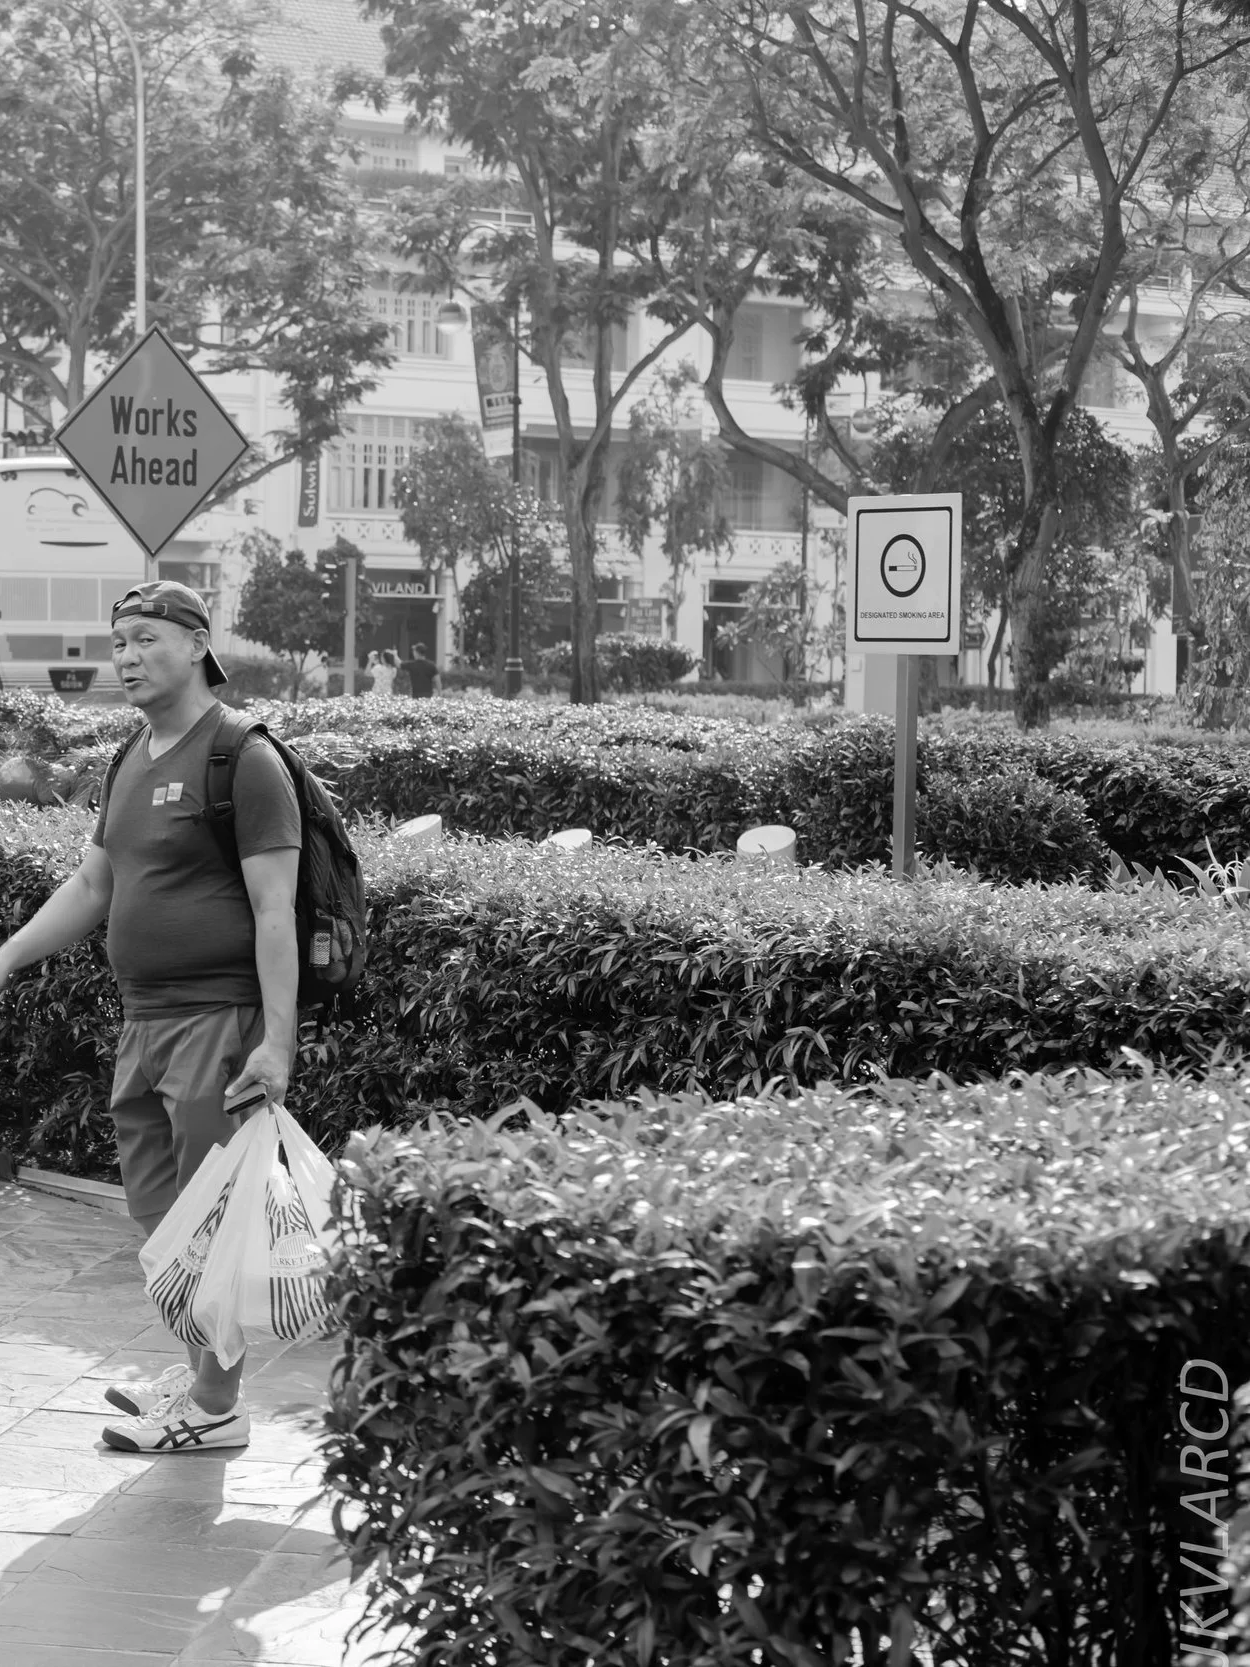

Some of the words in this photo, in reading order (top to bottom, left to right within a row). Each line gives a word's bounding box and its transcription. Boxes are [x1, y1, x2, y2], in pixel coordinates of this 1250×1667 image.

[110, 395, 197, 437] Works
[110, 445, 197, 486] Ahead
[860, 611, 898, 619] DESIGNATED
[898, 611, 927, 619] SMOKING
[928, 611, 945, 619] AREA
